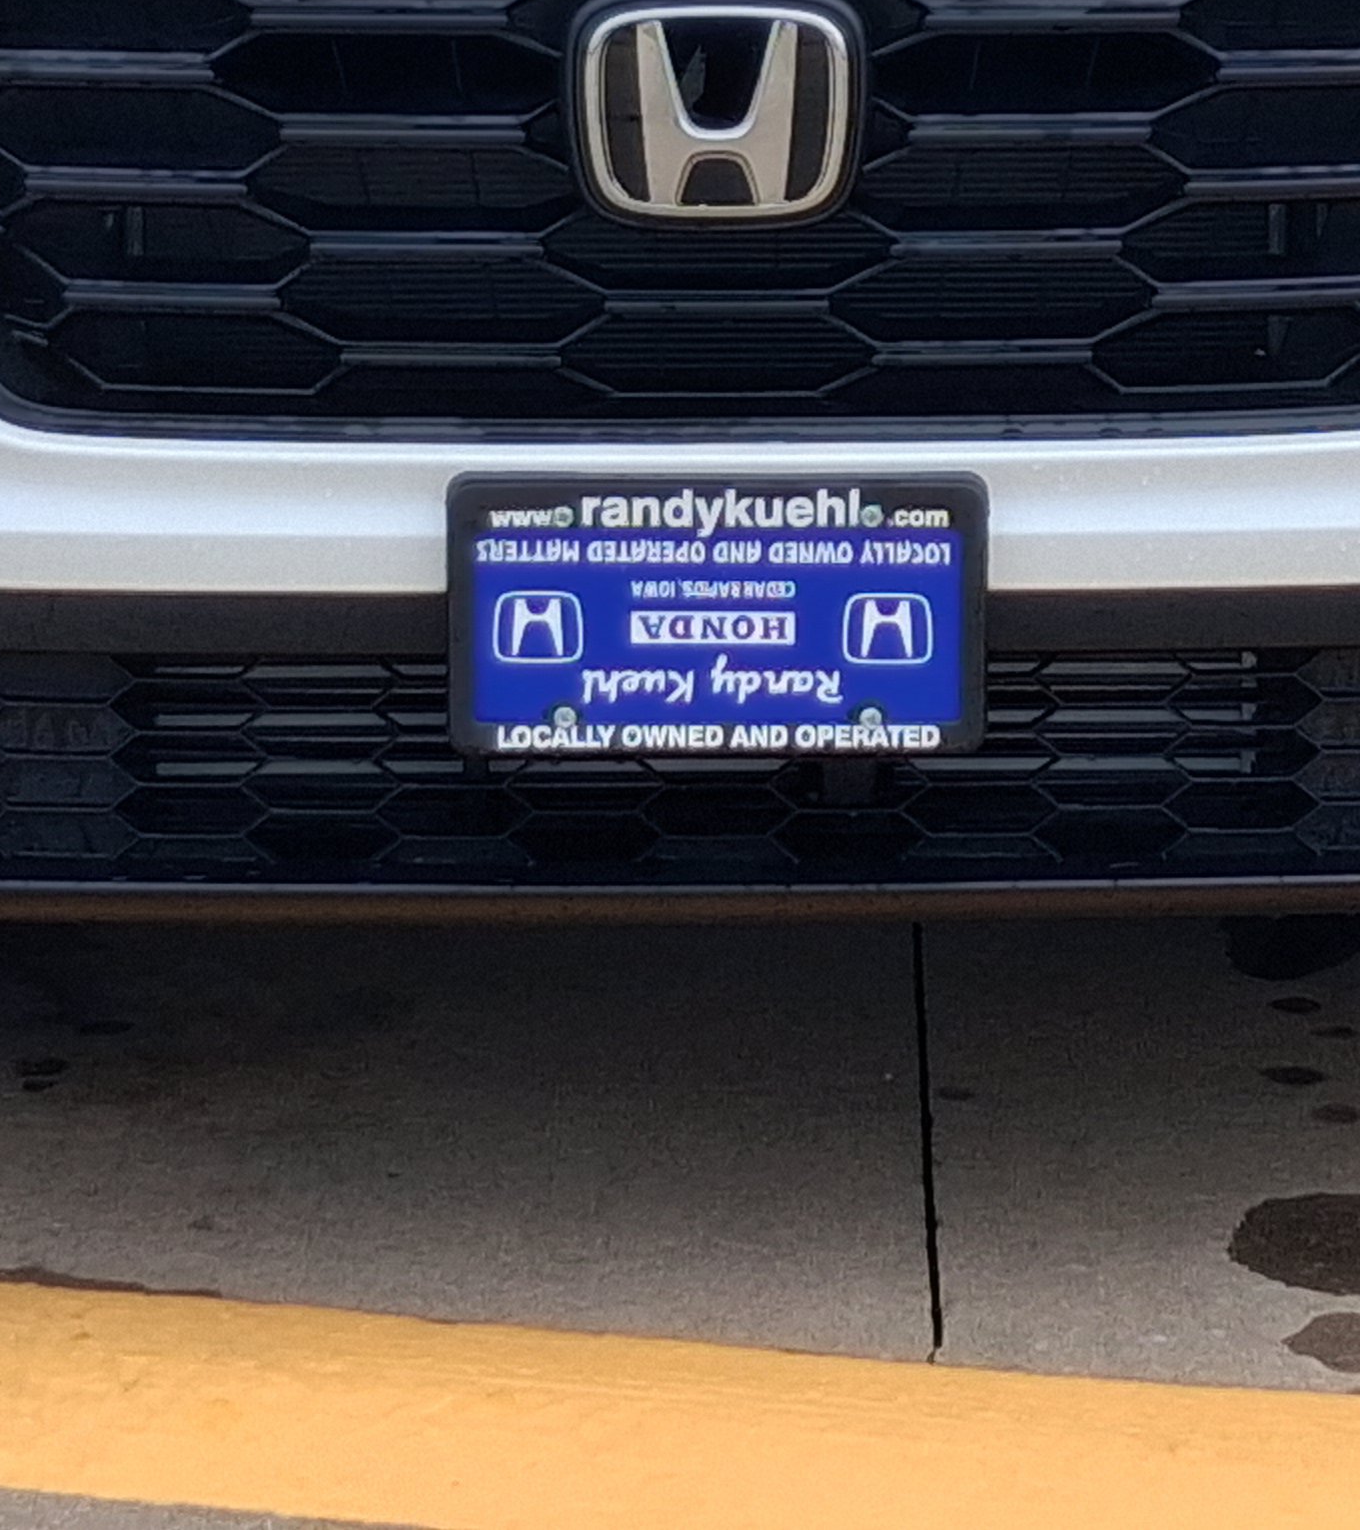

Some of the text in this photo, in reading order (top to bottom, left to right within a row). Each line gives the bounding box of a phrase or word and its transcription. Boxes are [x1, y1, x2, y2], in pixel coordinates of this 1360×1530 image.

[580, 487, 861, 538] randykuehl
[475, 537, 952, 566] LOCALLY OWNED AND OPERATED MATTERS
[638, 615, 788, 640] HONDA
[582, 653, 844, 704] Randy Kuehl
[497, 724, 941, 749] LOCALLY OWNED AND OPERATED
